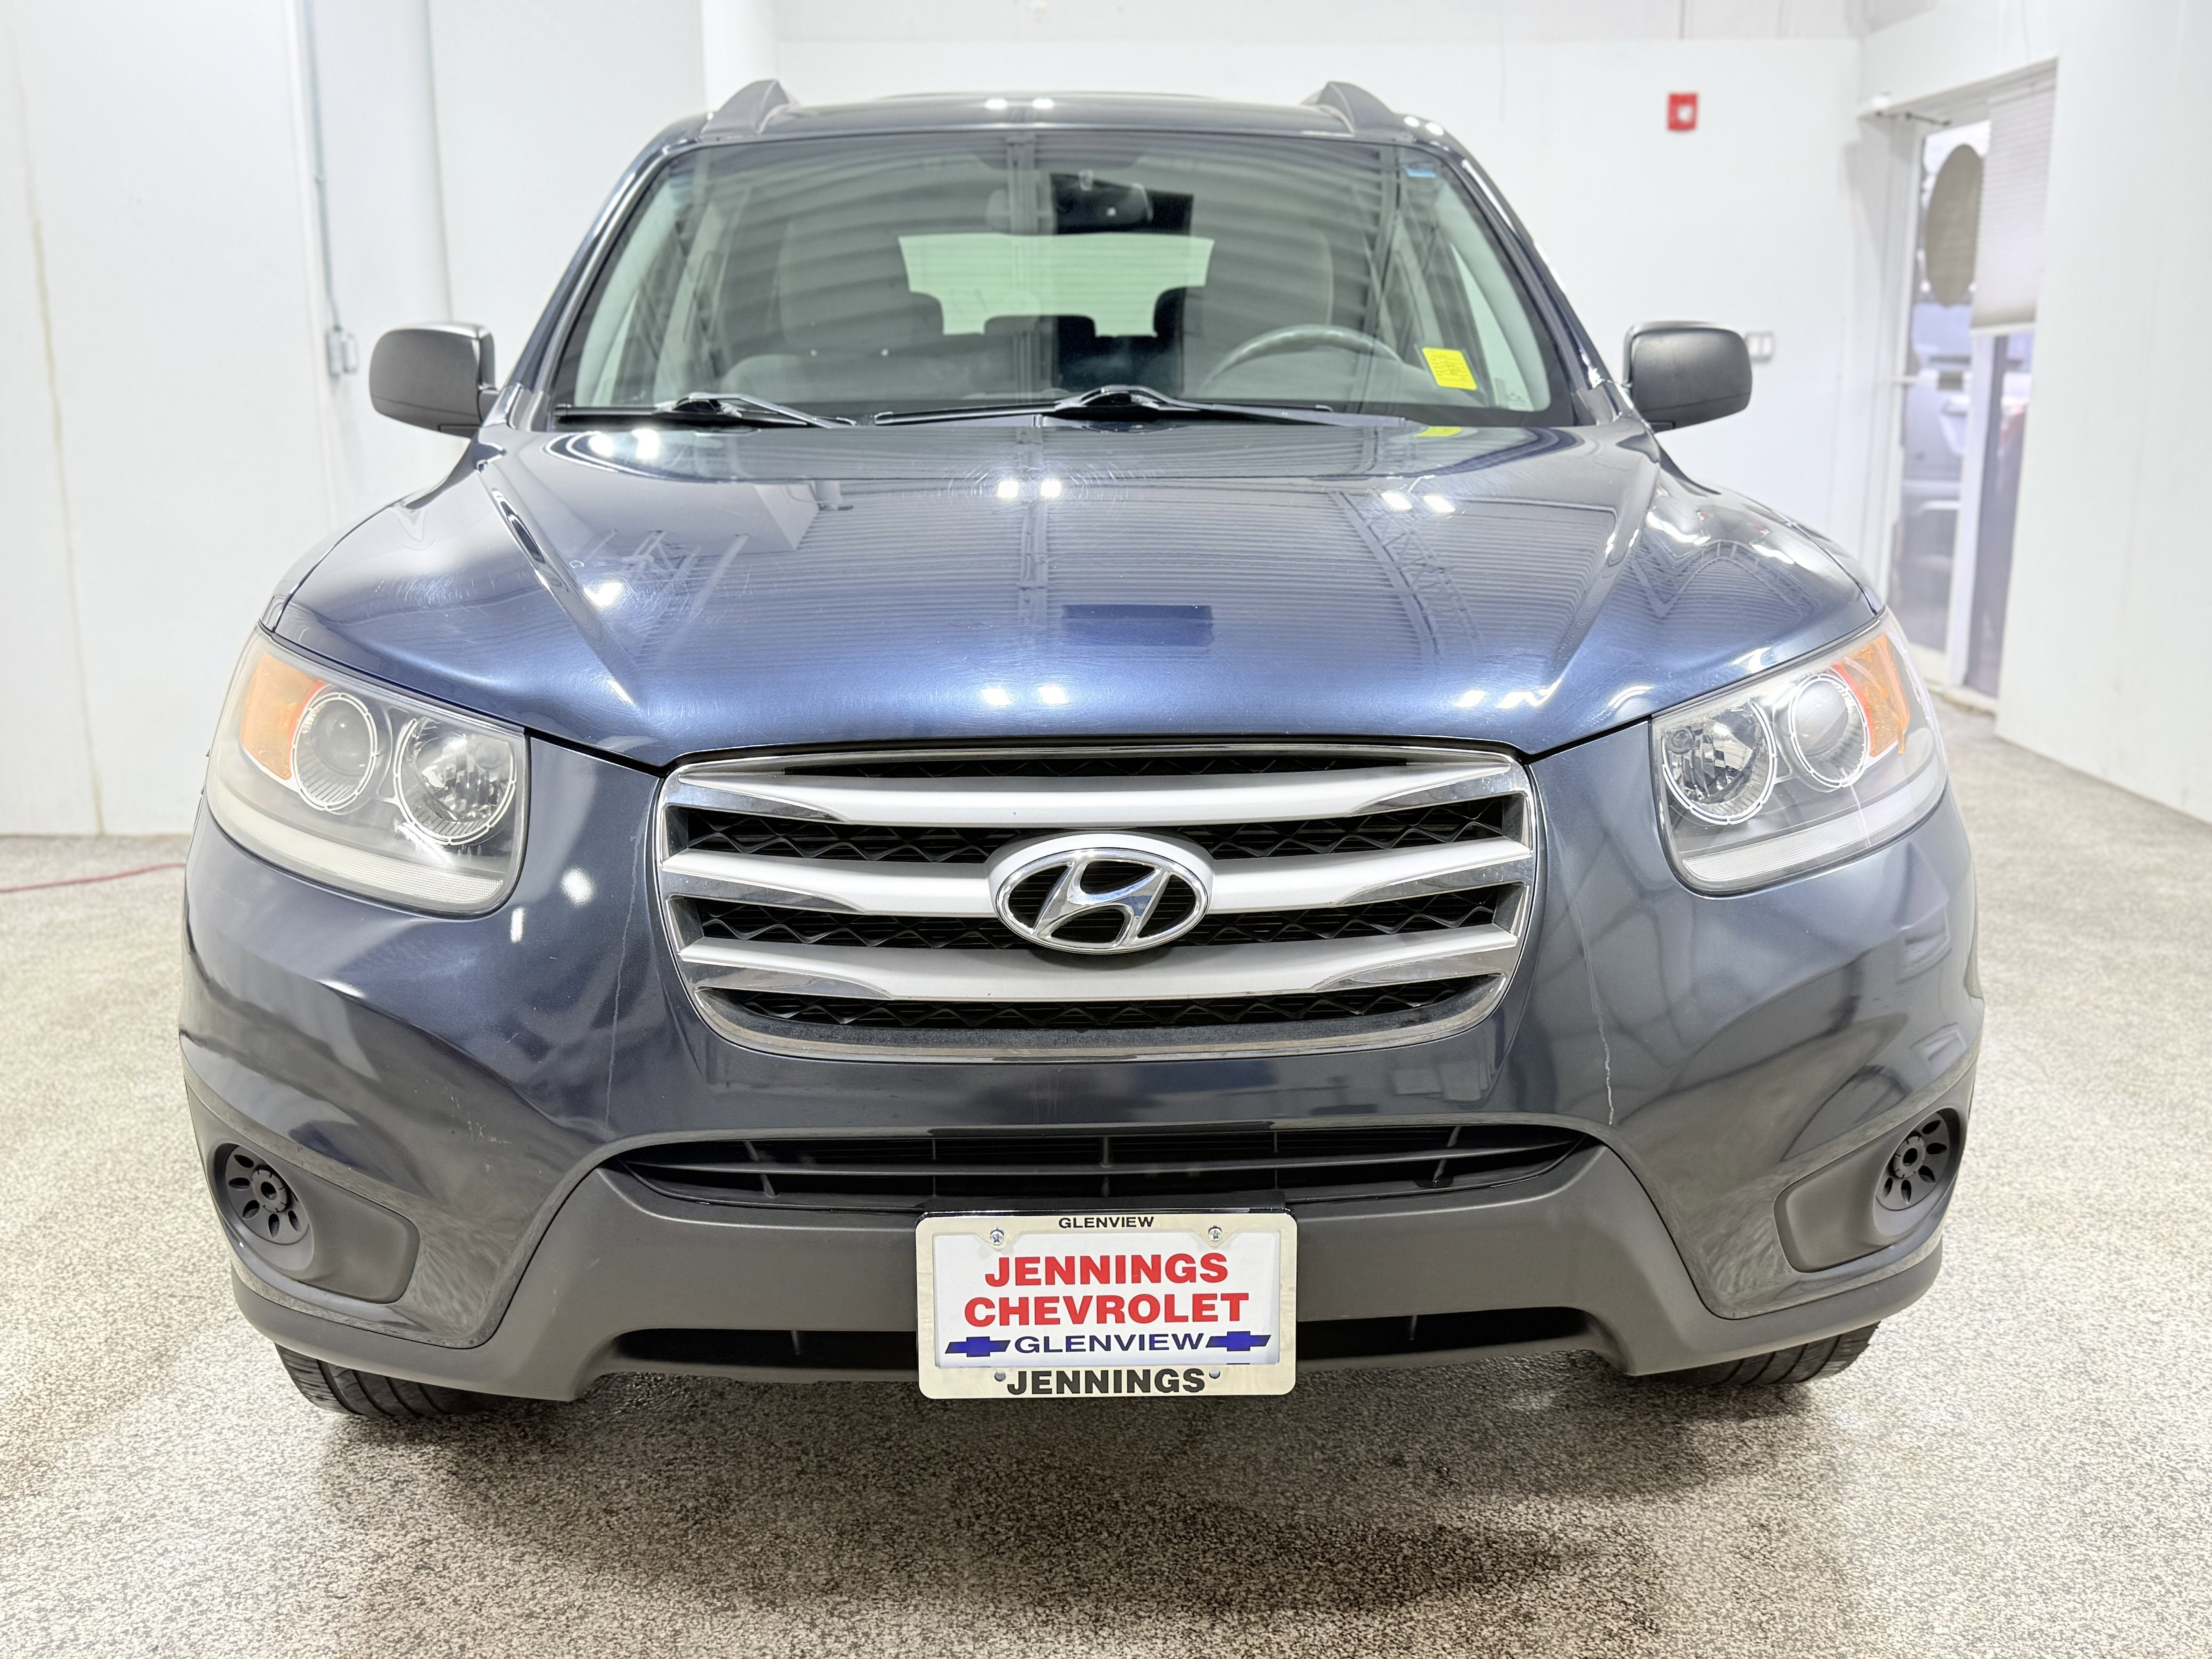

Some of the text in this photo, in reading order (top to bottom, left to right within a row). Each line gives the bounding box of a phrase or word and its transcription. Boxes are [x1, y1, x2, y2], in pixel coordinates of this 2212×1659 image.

[1058, 1216, 1154, 1228] GLENVIEW
[985, 1253, 1228, 1287] JENNINGS
[965, 1293, 1249, 1327] CHEVROLET
[1014, 1333, 1204, 1353] GLENVIEW
[1006, 1368, 1205, 1395] JENNINGS
